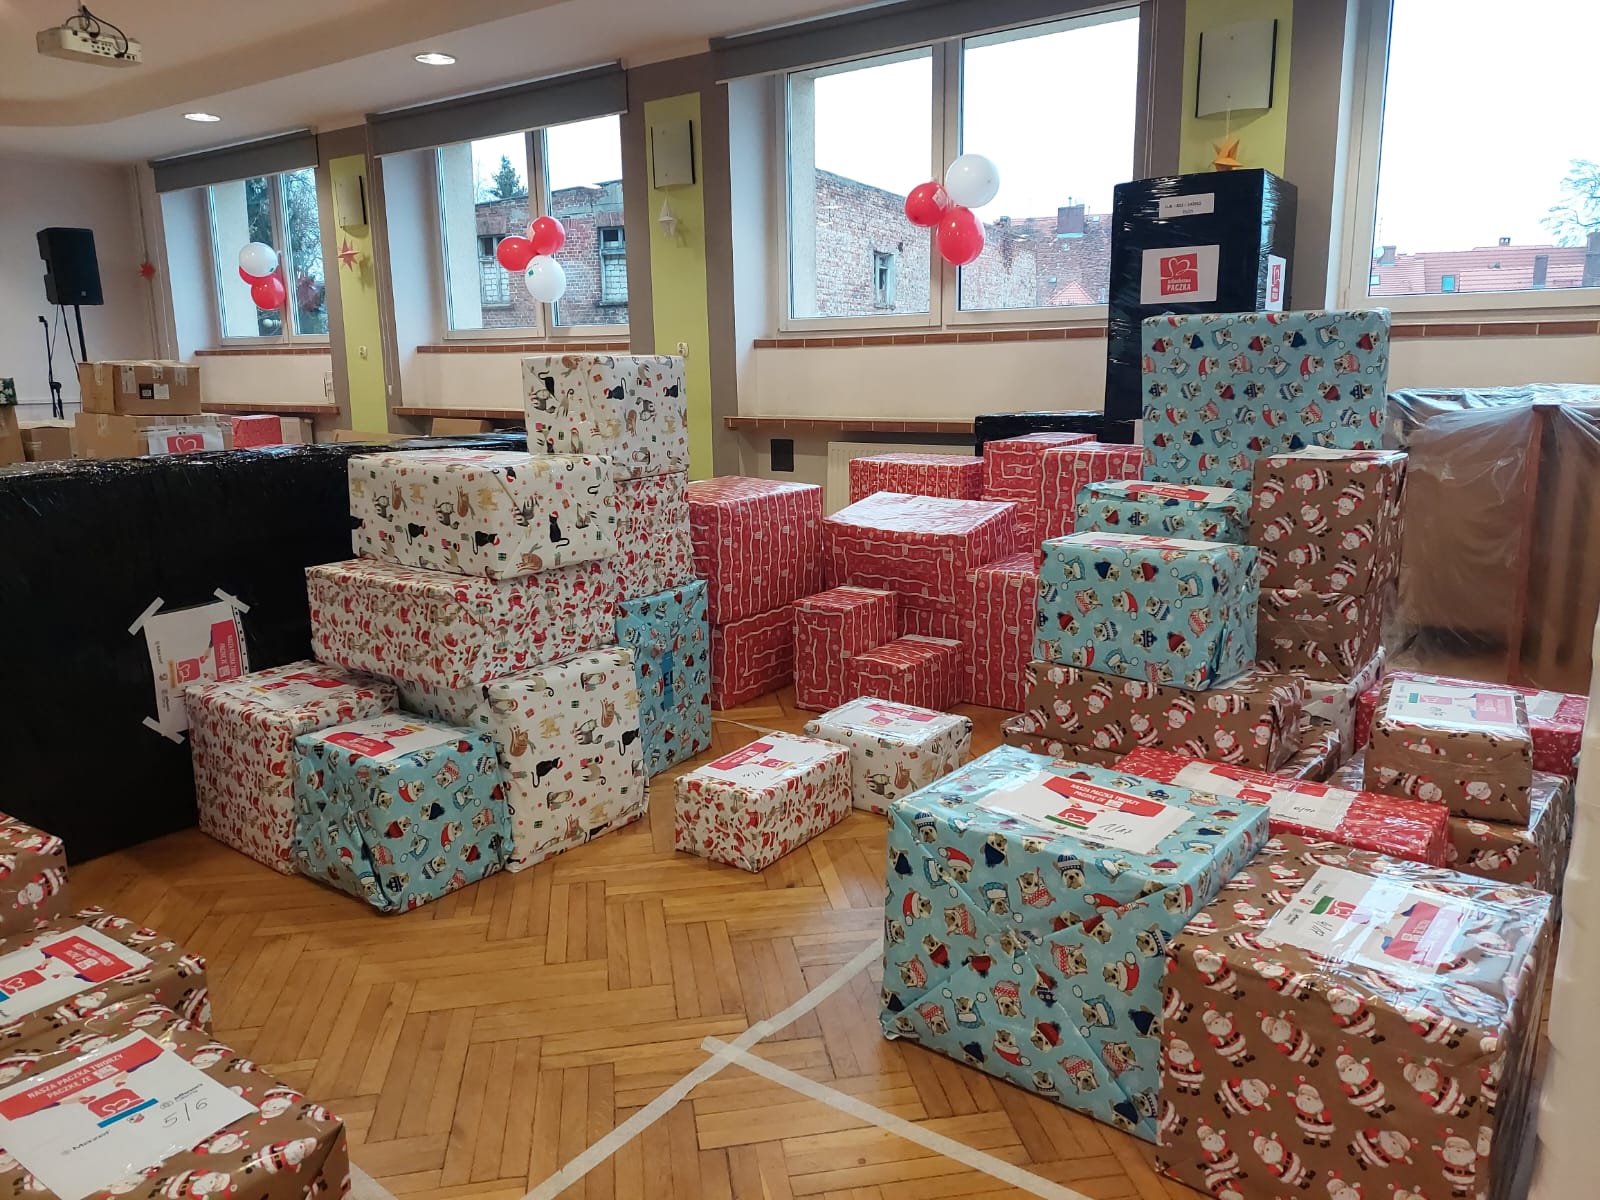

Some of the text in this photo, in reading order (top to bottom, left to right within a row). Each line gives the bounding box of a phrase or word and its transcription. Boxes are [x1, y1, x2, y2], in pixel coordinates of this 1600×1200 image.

[1167, 283, 1191, 291] PACZKA
[27, 1082, 57, 1098] NASZA
[56, 1068, 90, 1086] PACZKA
[89, 1053, 124, 1071] TWORZY
[46, 1075, 92, 1099] PACZKĘ ZE
